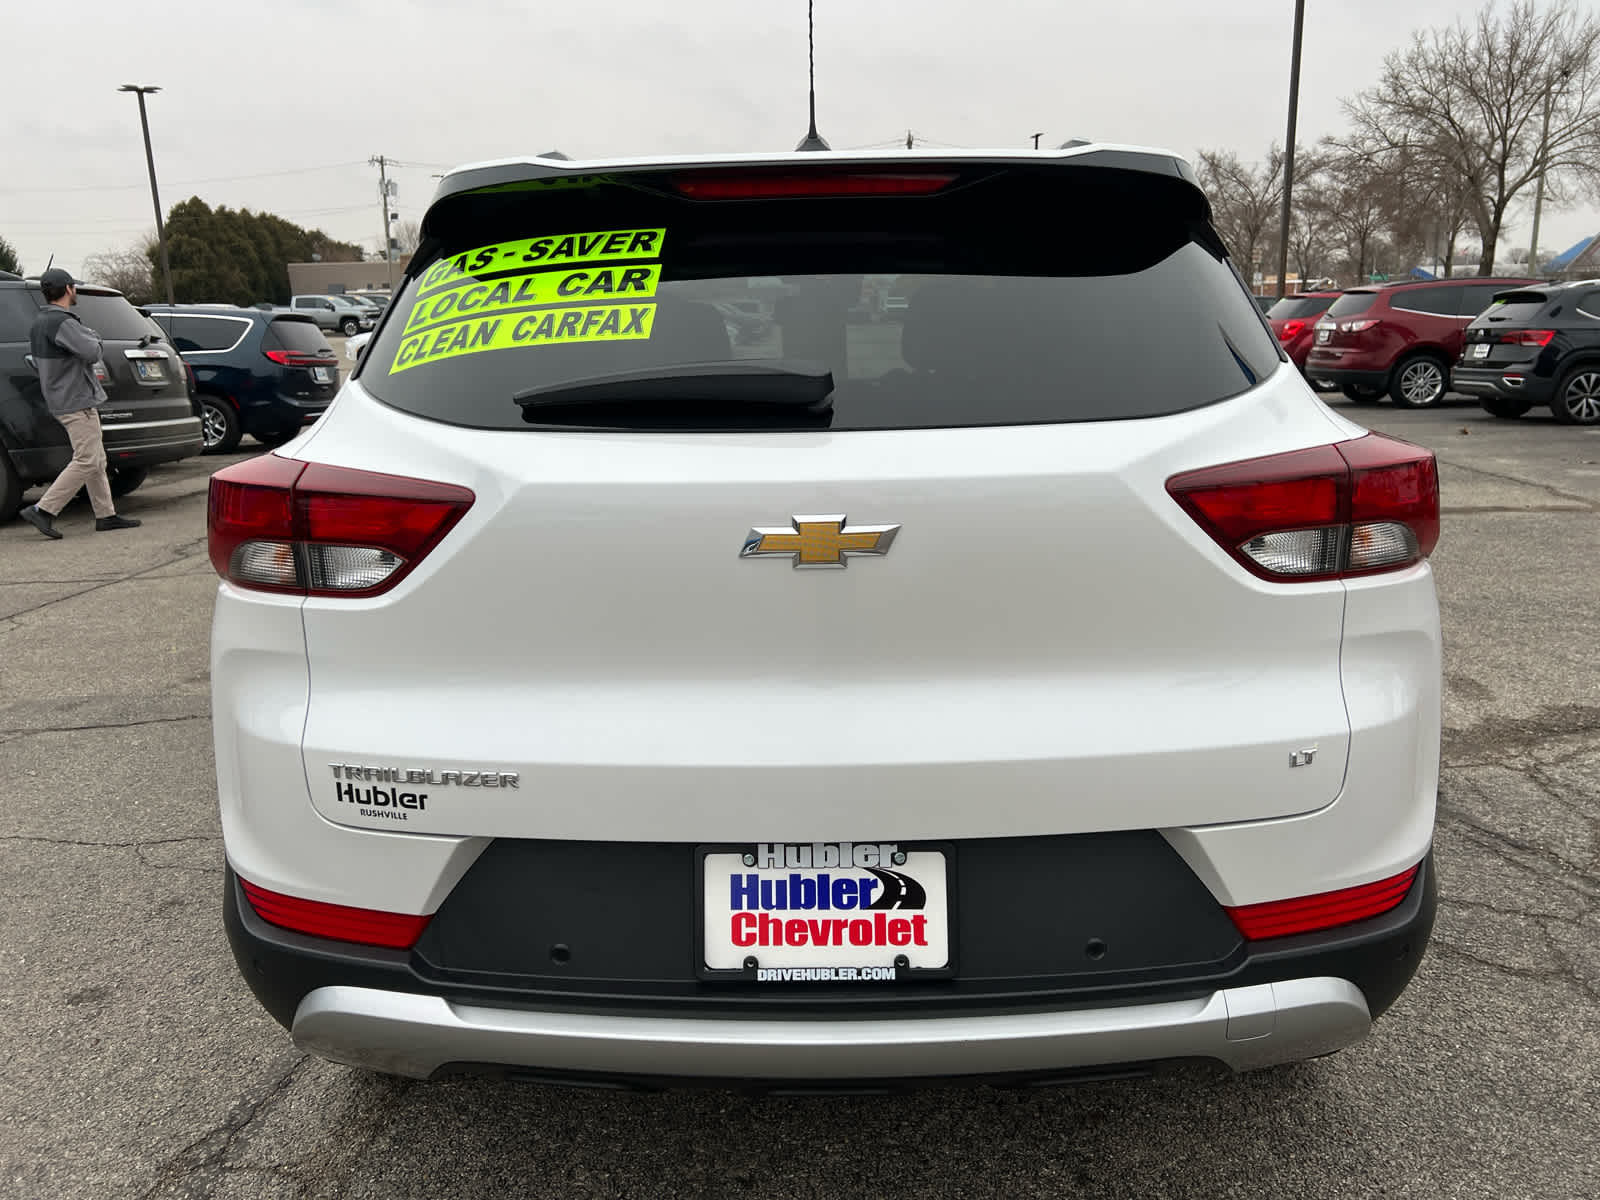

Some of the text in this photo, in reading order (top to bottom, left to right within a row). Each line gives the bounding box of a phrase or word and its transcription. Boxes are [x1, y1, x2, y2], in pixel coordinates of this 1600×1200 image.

[408, 268, 652, 329] LOCAL CAR
[396, 308, 650, 367] CLEAN CARFAX
[1289, 748, 1317, 768] LT
[328, 762, 521, 788] TRAILBLAZER
[336, 781, 428, 810] Hubler
[360, 808, 408, 821] RUSHVILLE
[757, 843, 898, 869] Hubler
[730, 873, 878, 910] Hubler
[731, 912, 928, 947] Chevrolet
[757, 967, 896, 981] DRIVEHUBLER.COM
